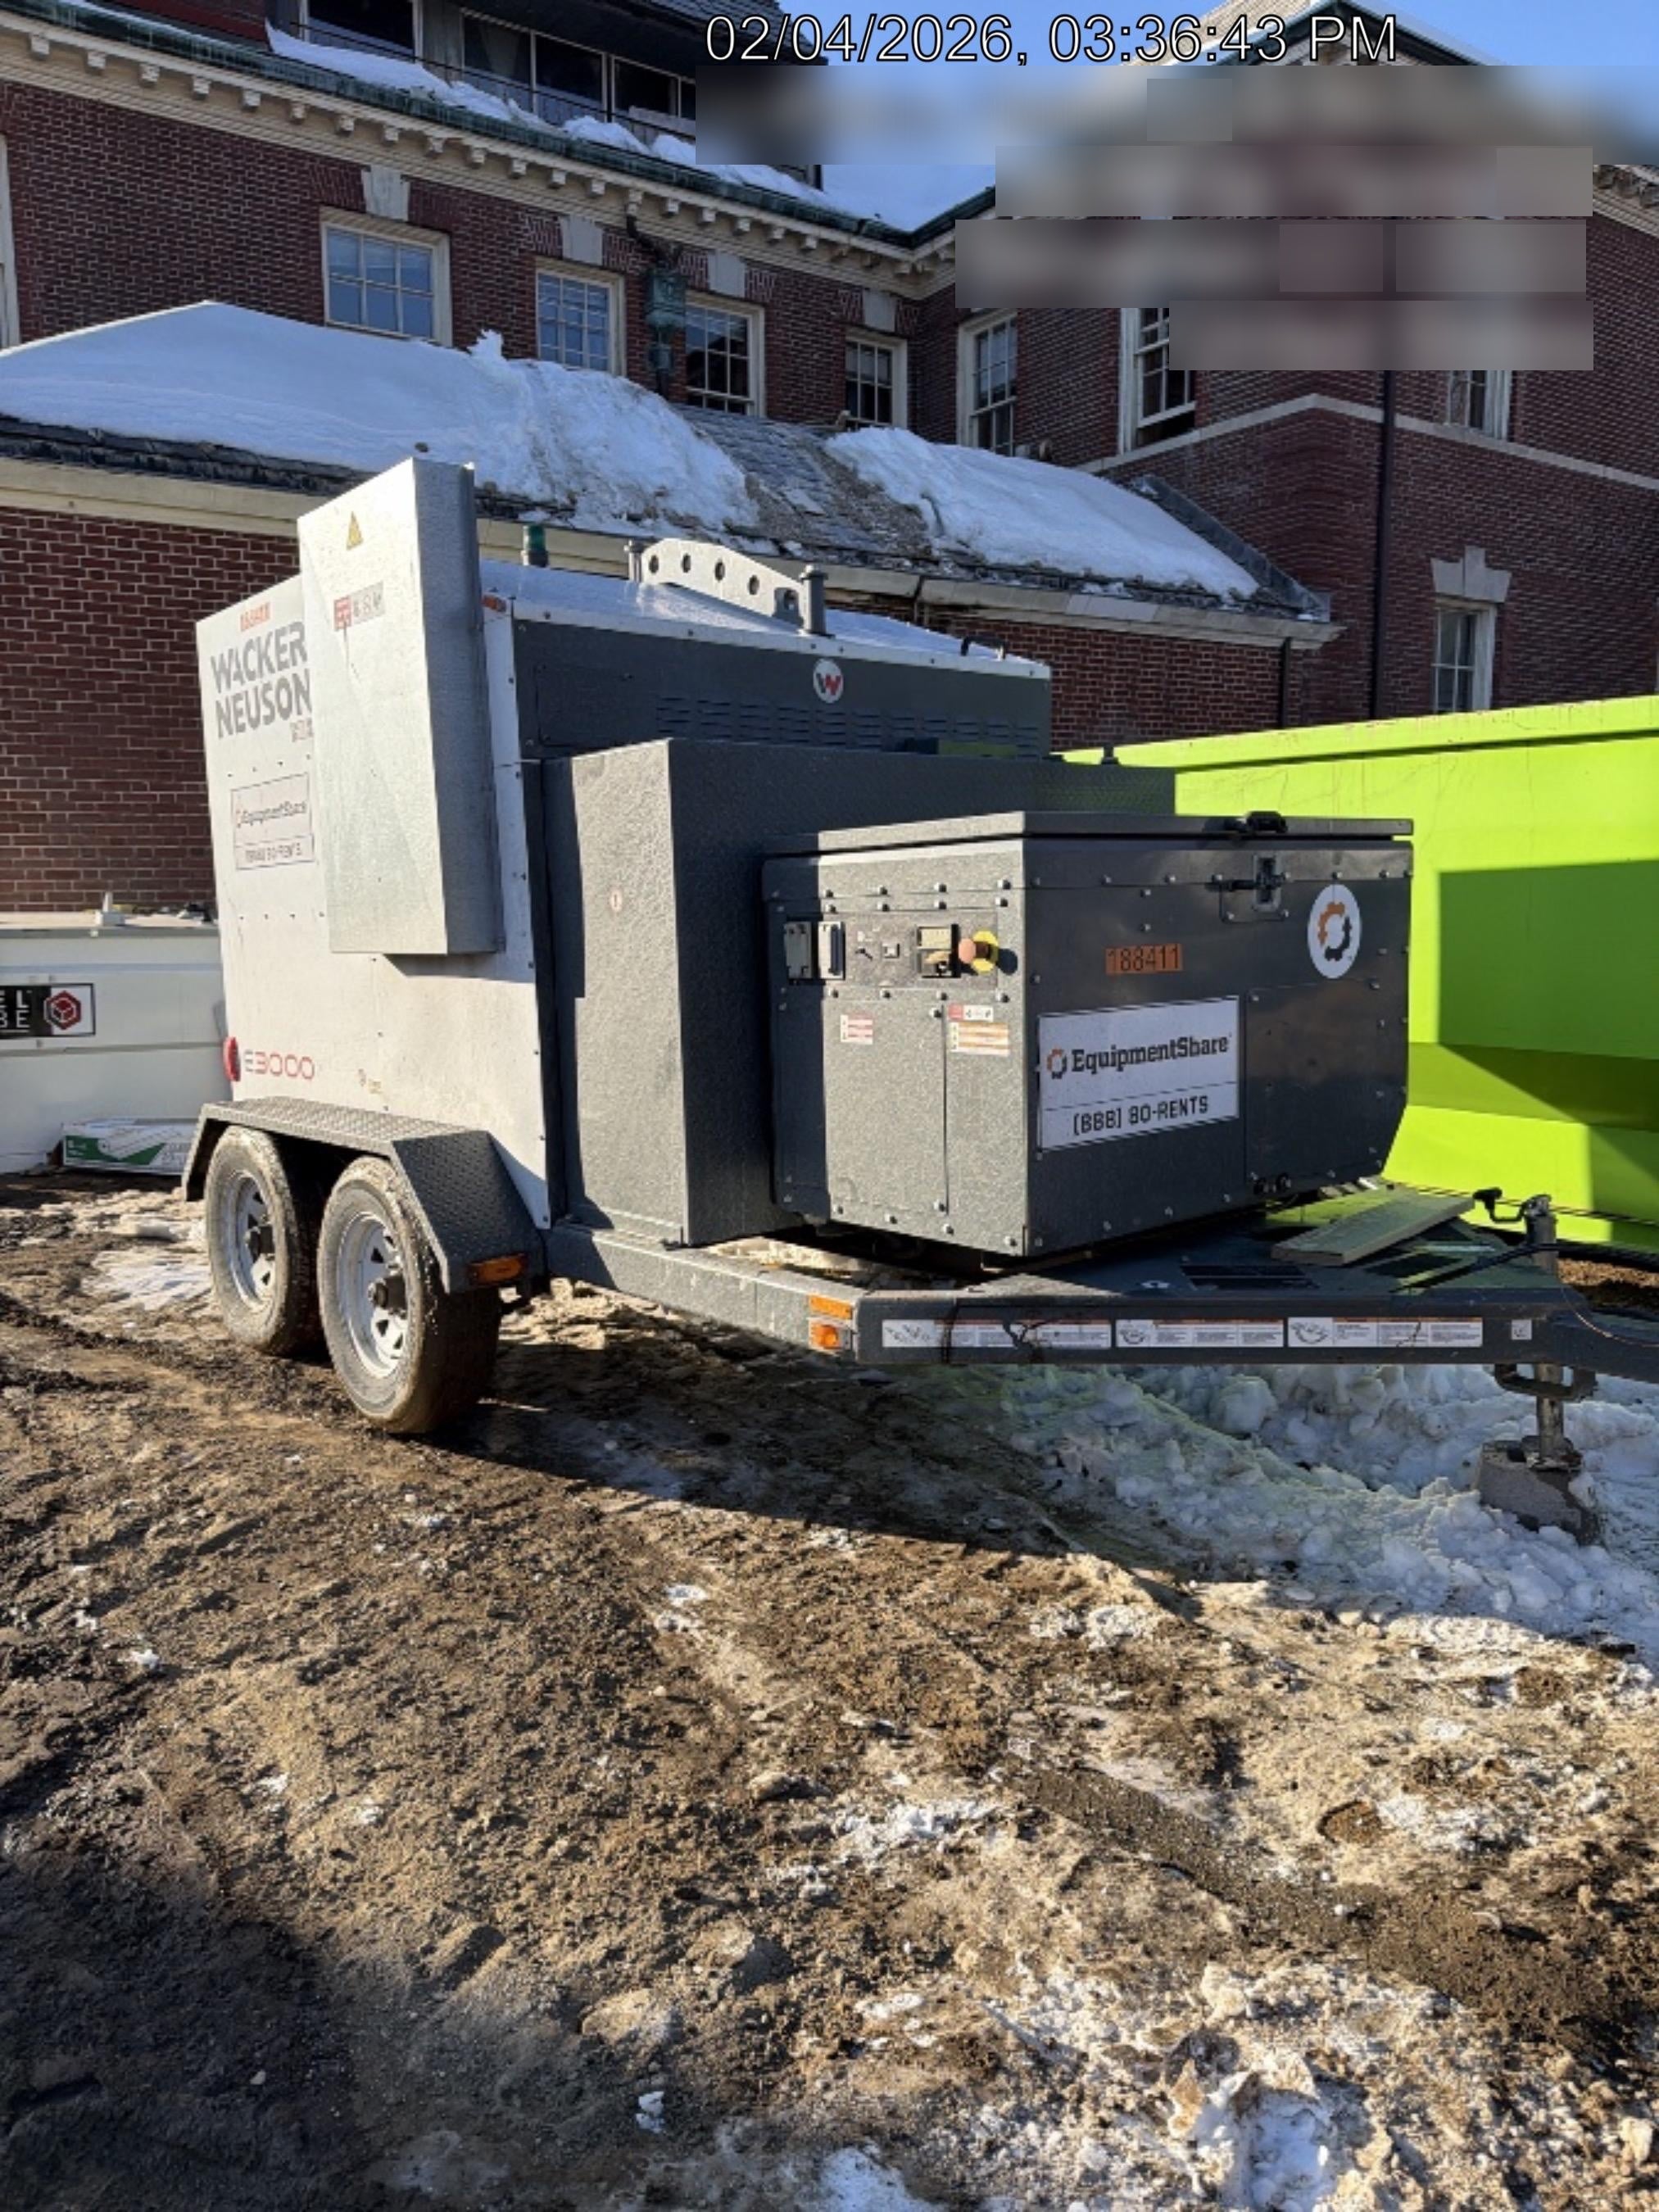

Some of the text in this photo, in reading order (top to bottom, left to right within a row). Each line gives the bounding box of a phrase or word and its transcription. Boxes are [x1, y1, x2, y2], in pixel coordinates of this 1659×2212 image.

[211, 621, 308, 694] WACKER
[215, 668, 312, 740] NEUSON
[1108, 945, 1181, 972] 188411
[1071, 1036, 1228, 1075] EquipmentShare
